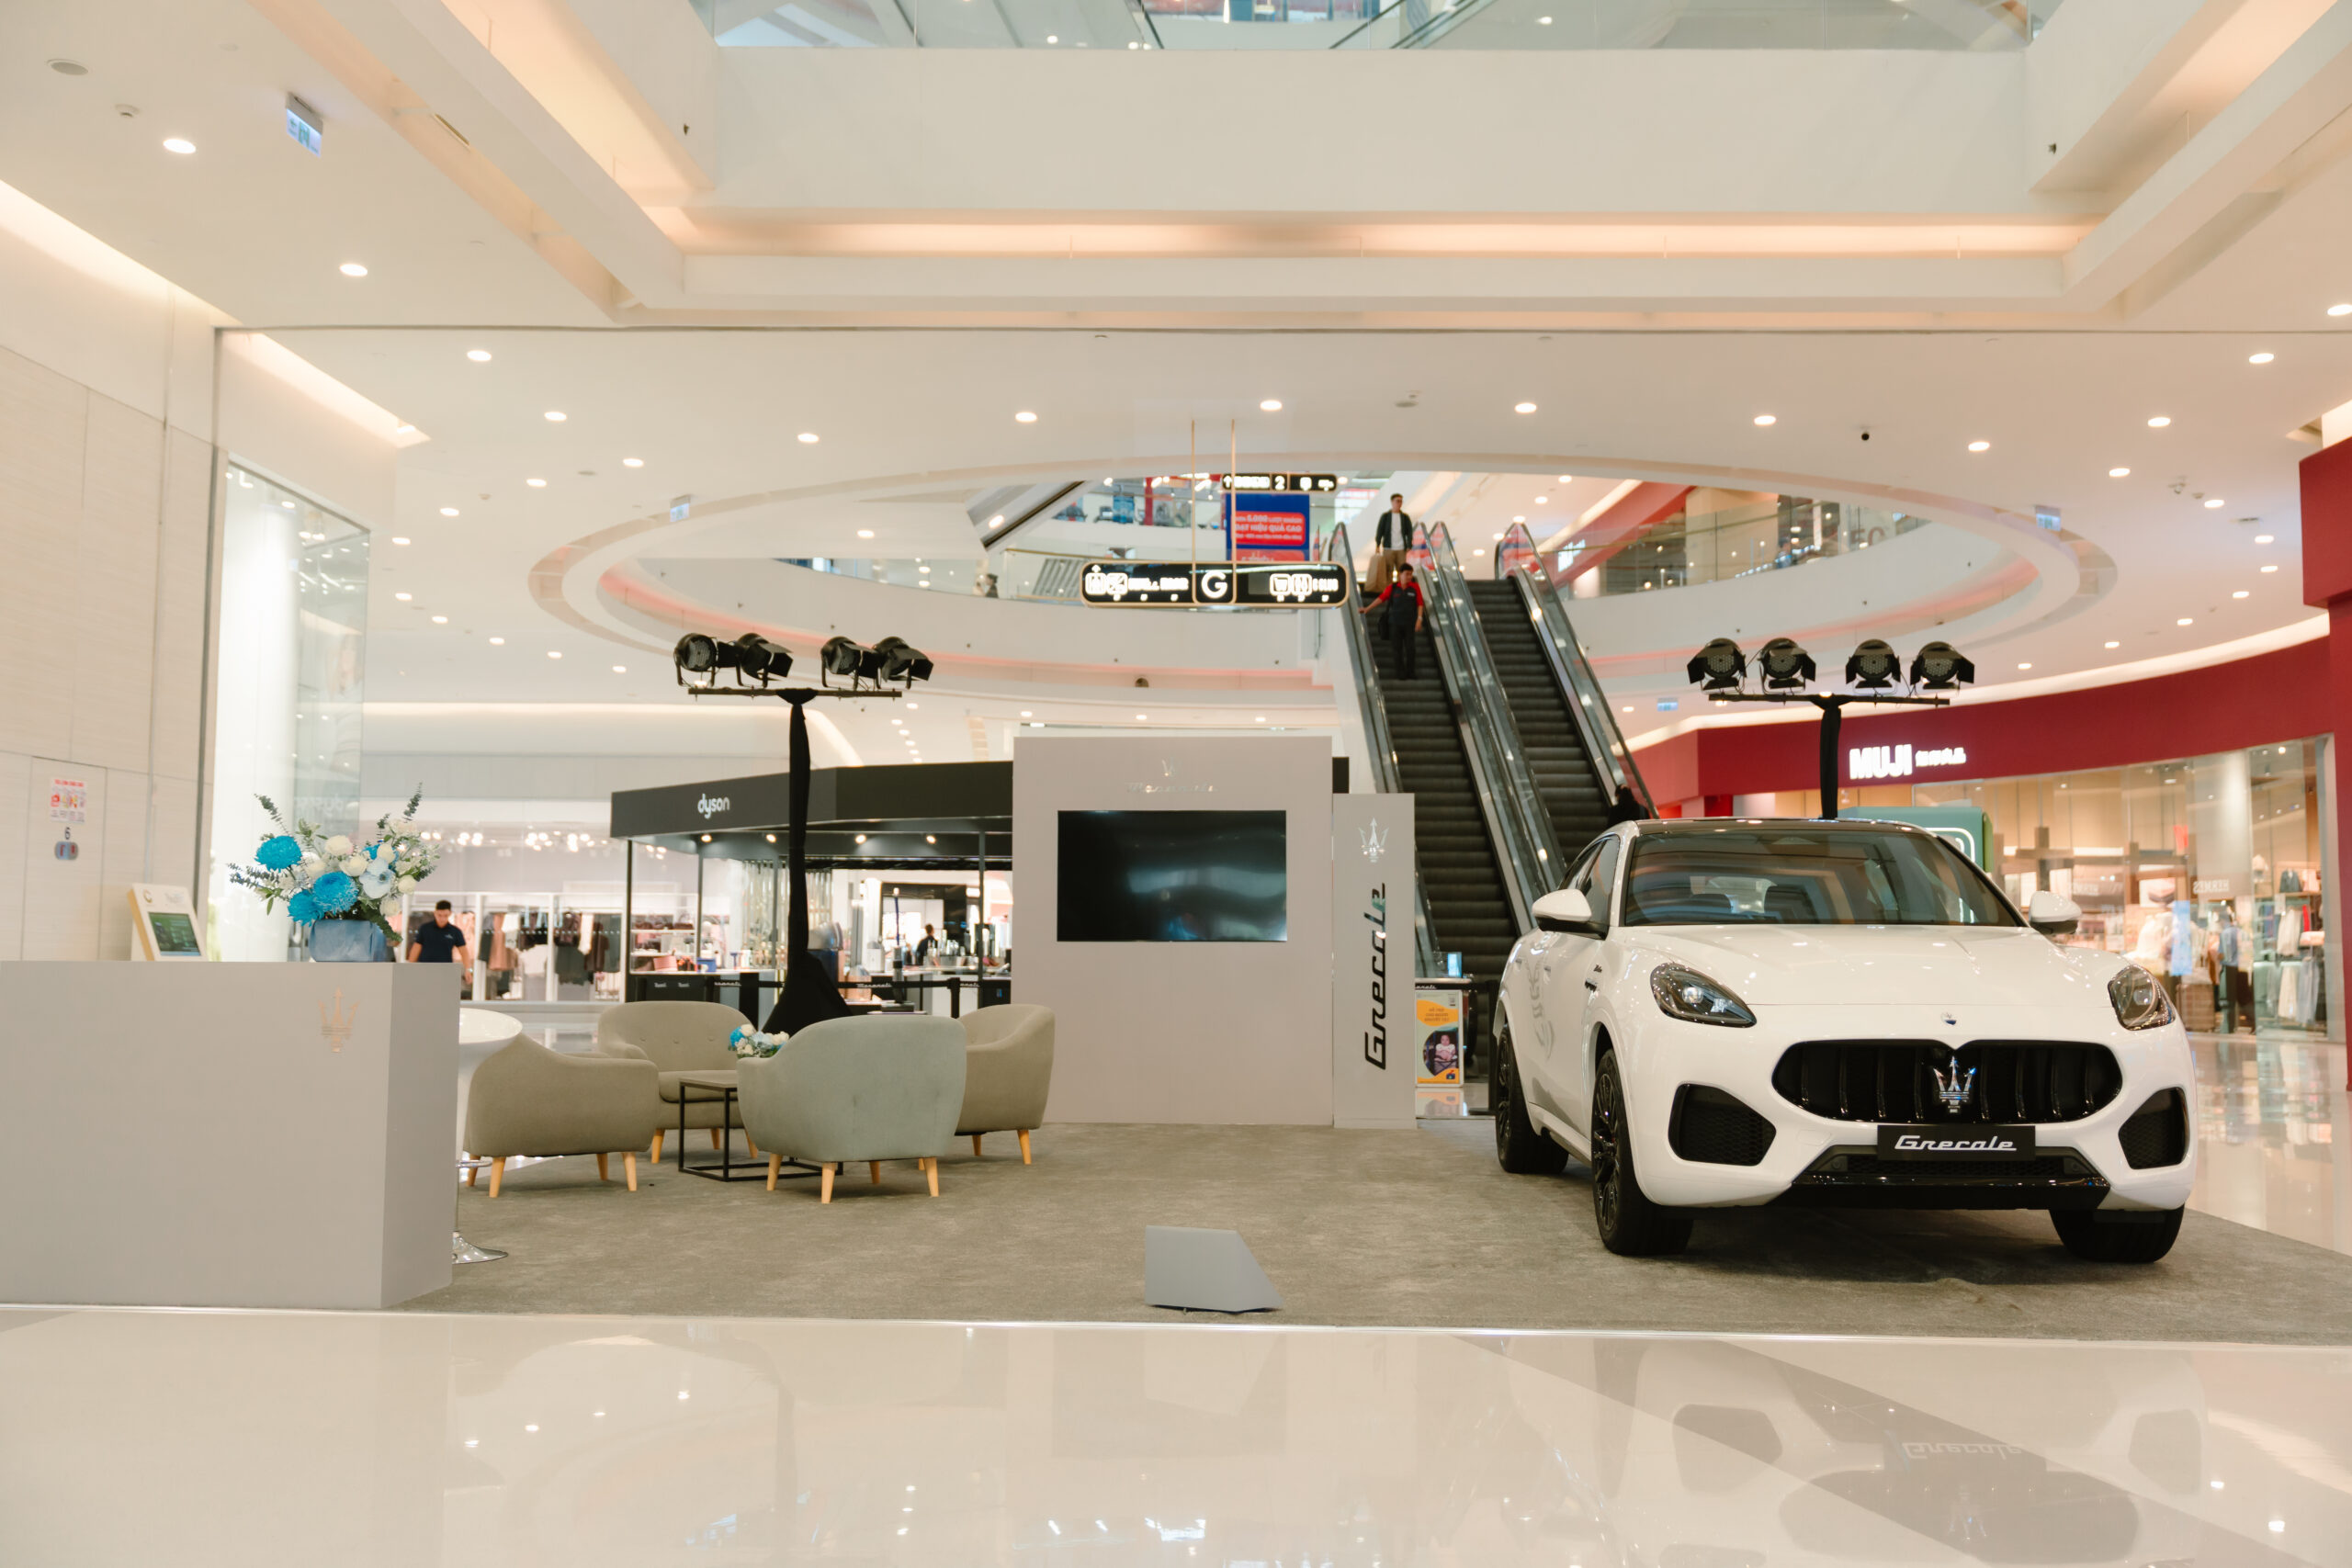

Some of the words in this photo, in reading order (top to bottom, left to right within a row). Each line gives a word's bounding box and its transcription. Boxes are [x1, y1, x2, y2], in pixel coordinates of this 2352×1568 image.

[1274, 475, 1285, 491] 2
[1201, 570, 1229, 600] G
[1849, 743, 1913, 780] MUJI
[697, 793, 730, 819] dyson
[1363, 883, 1386, 1071] Grecale
[1894, 1134, 2018, 1152] Grecale
